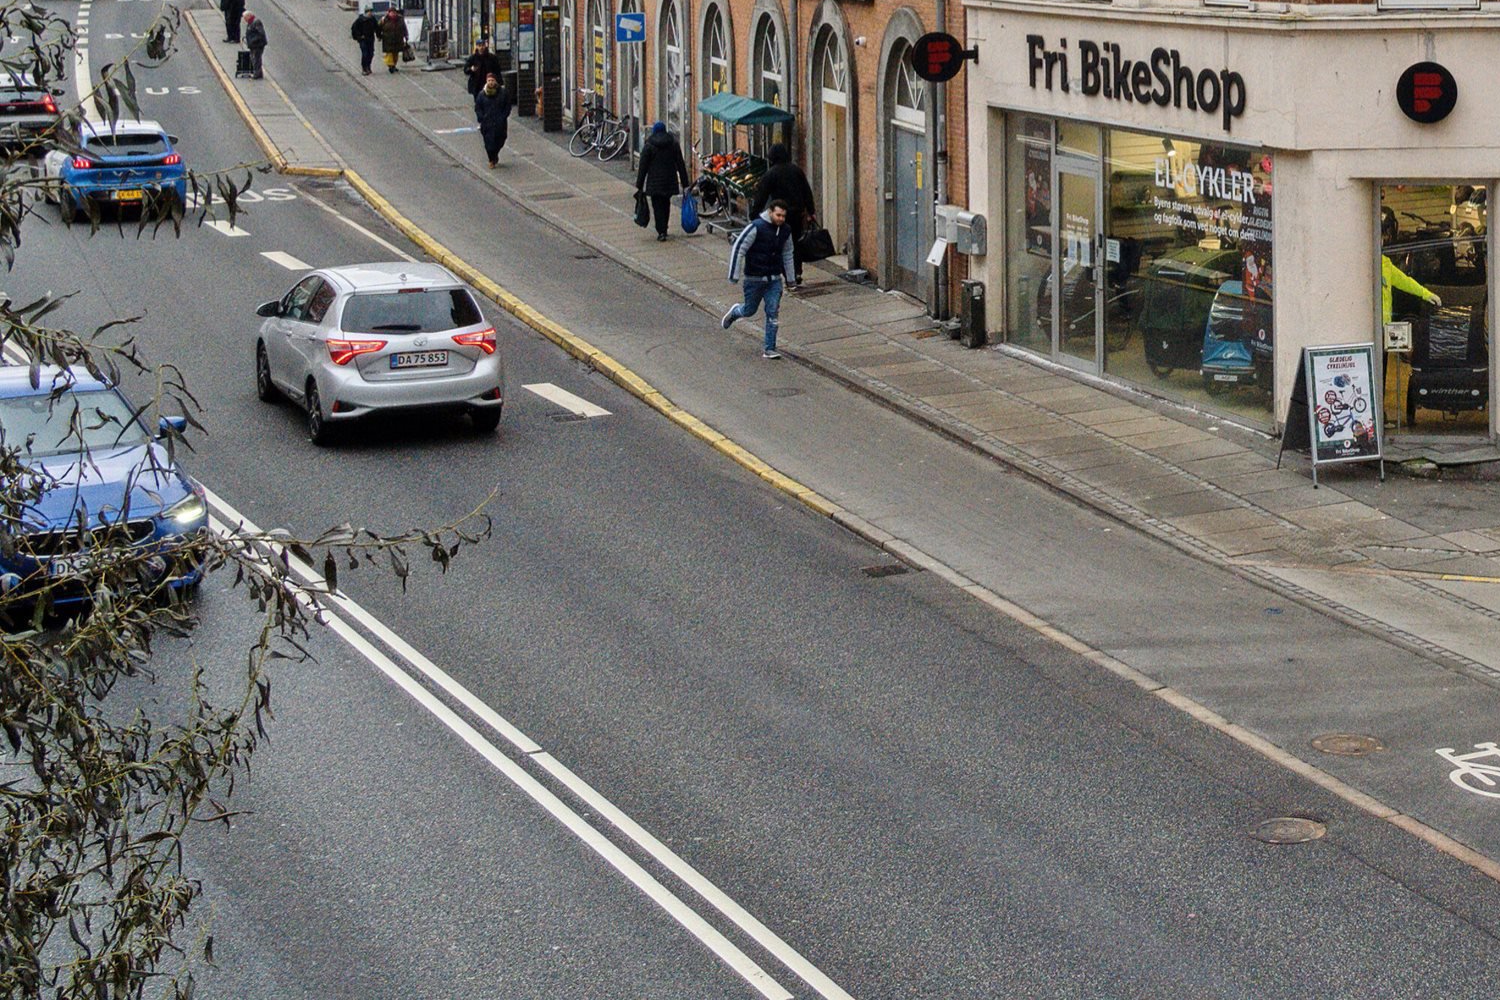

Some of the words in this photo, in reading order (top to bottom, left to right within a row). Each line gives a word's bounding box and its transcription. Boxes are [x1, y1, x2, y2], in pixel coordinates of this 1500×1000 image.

[1026, 34, 1070, 94] Fri
[1078, 39, 1247, 132] BikeShop
[1155, 157, 1256, 204] EL-CYKLER
[1154, 196, 1171, 209] Byens
[1172, 200, 1192, 213] største
[1193, 205, 1214, 220] udvalg
[1154, 213, 1162, 224] og
[1163, 213, 1182, 227] fagfolk
[1183, 219, 1197, 230] som
[1198, 221, 1209, 232] ved
[1210, 223, 1228, 237] noget
[1228, 228, 1239, 237] om
[398, 355, 412, 365] DA
[414, 354, 426, 363] 75
[428, 353, 446, 363] 853
